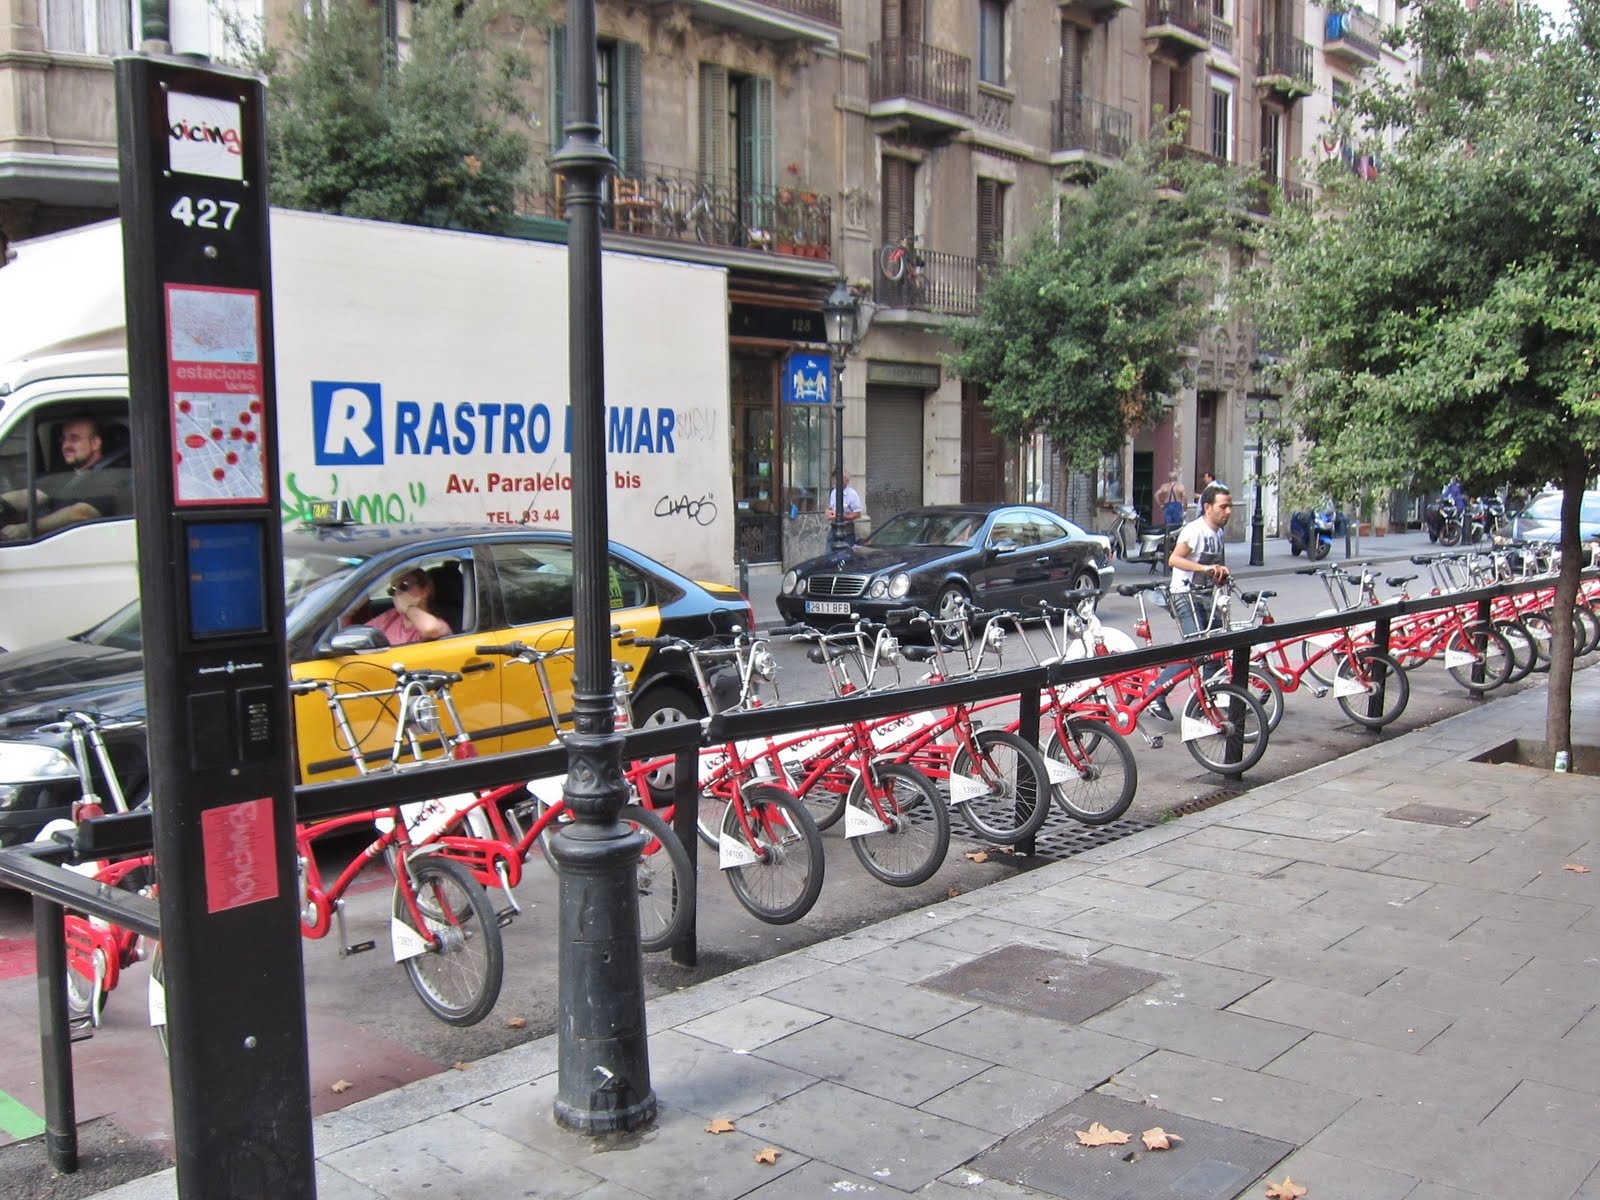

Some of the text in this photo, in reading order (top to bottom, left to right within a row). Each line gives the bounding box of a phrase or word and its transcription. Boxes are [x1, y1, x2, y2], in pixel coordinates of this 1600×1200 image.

[170, 195, 241, 231] 427
[176, 364, 257, 381] estacions
[323, 387, 378, 459] R
[394, 400, 551, 455] RASTRO
[446, 470, 641, 494] Av. Paralelo bis
[486, 511, 519, 524] TEL.
[543, 508, 560, 521] 44
[810, 603, 849, 613] 2911 BFB
